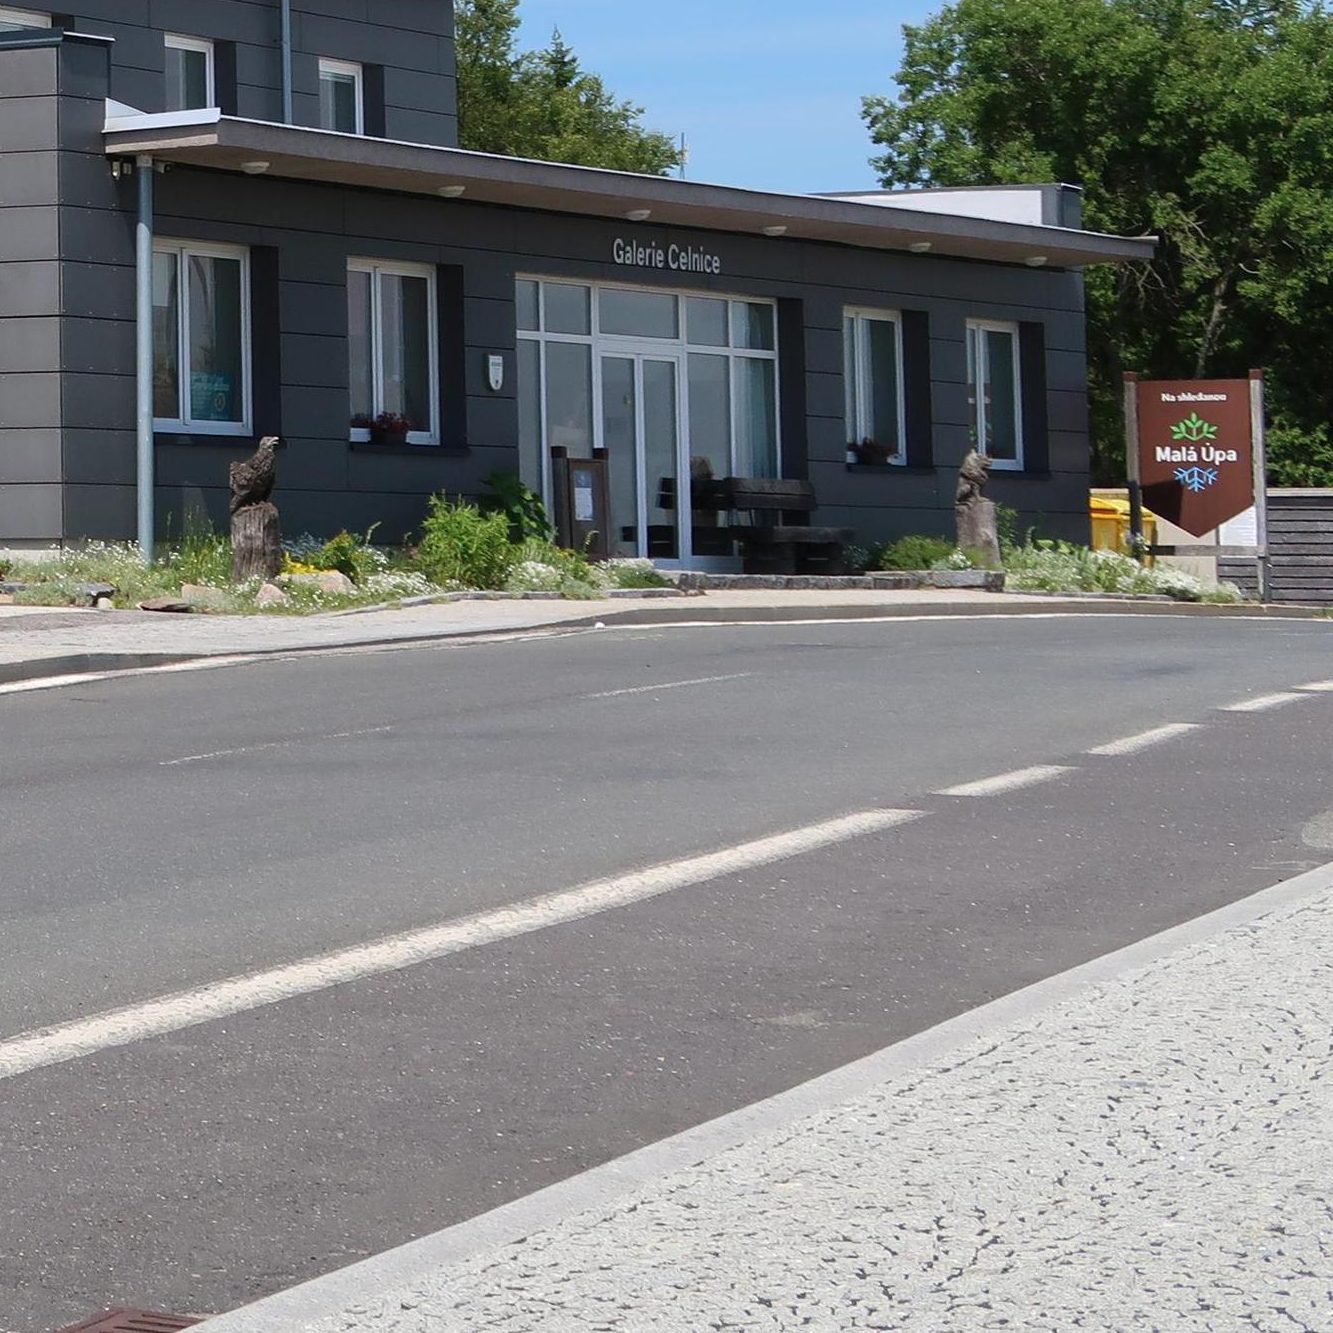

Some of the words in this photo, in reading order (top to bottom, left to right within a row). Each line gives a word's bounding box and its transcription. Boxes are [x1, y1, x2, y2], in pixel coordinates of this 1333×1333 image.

[613, 238, 665, 268] Galerie
[668, 243, 721, 274] Celnice
[1160, 393, 1176, 402] Na
[1155, 446, 1198, 463] Malá
[1201, 442, 1238, 466] Úpa
